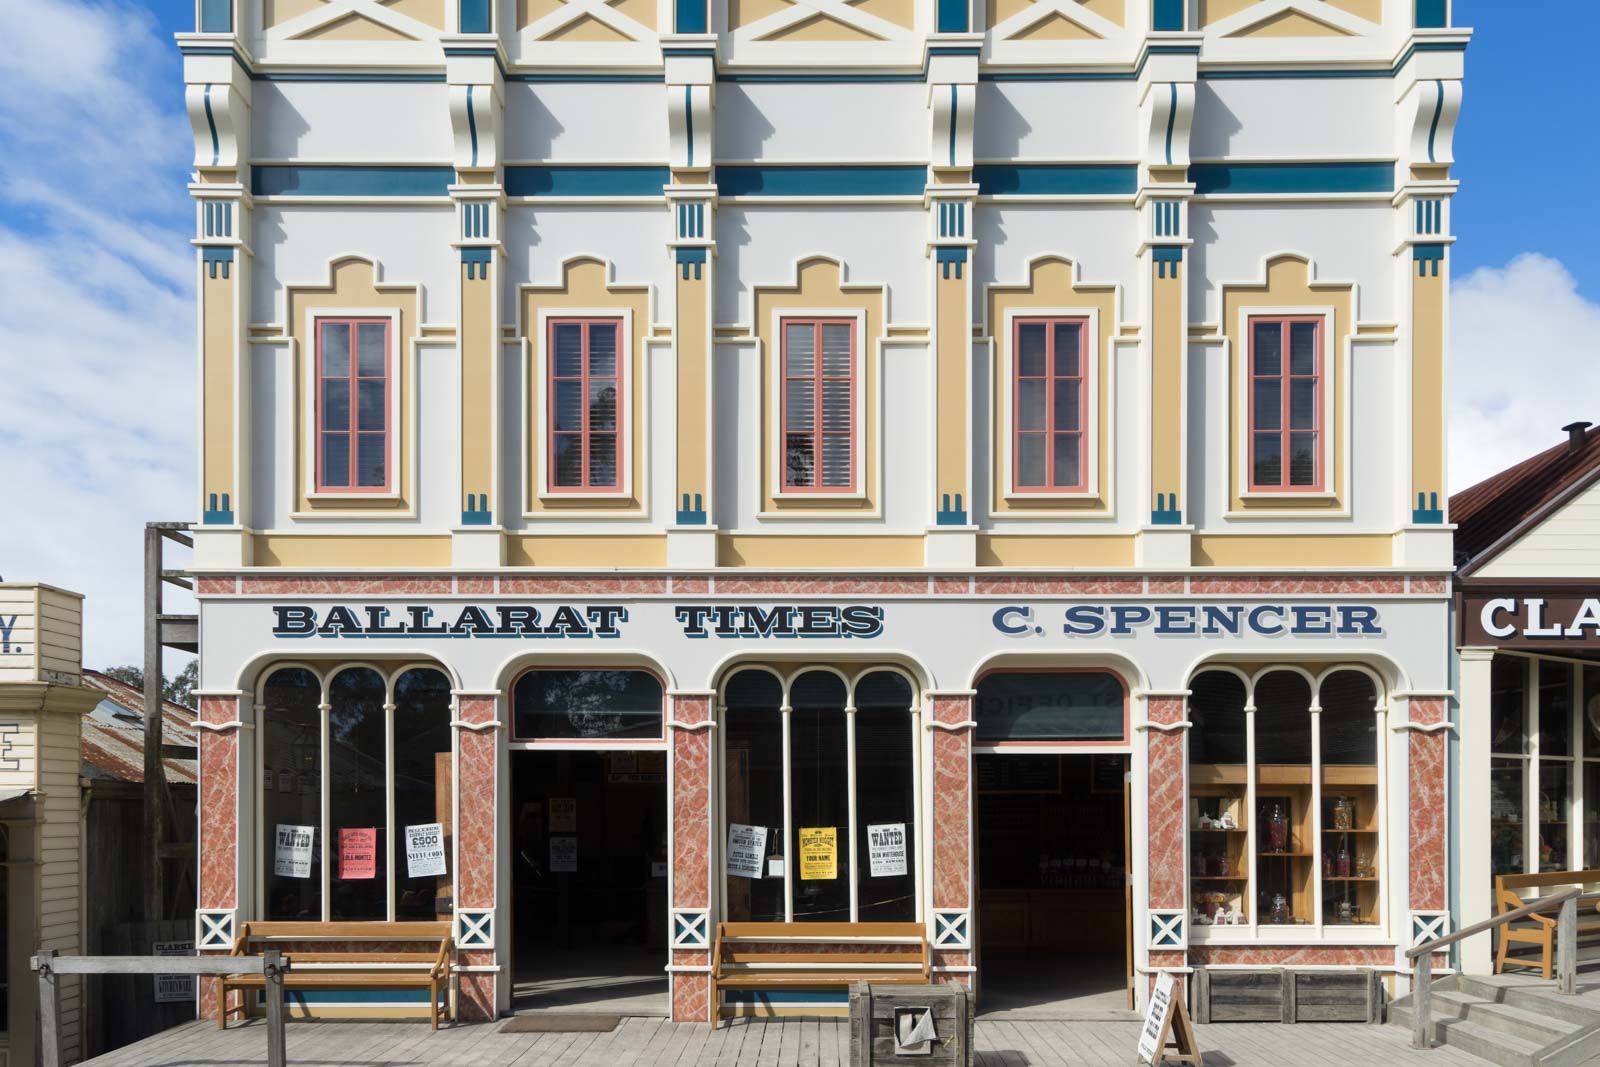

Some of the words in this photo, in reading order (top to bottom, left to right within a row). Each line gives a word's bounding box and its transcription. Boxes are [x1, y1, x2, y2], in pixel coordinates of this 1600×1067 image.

[273, 606, 629, 638] BALLARAT
[675, 606, 884, 638] TIMES
[992, 605, 1046, 638] C.
[1064, 605, 1387, 638] SPENCER
[279, 832, 310, 847] WANTED
[412, 836, 438, 846] £500
[871, 831, 903, 847] WANTED
[155, 943, 194, 951] CLARKE
